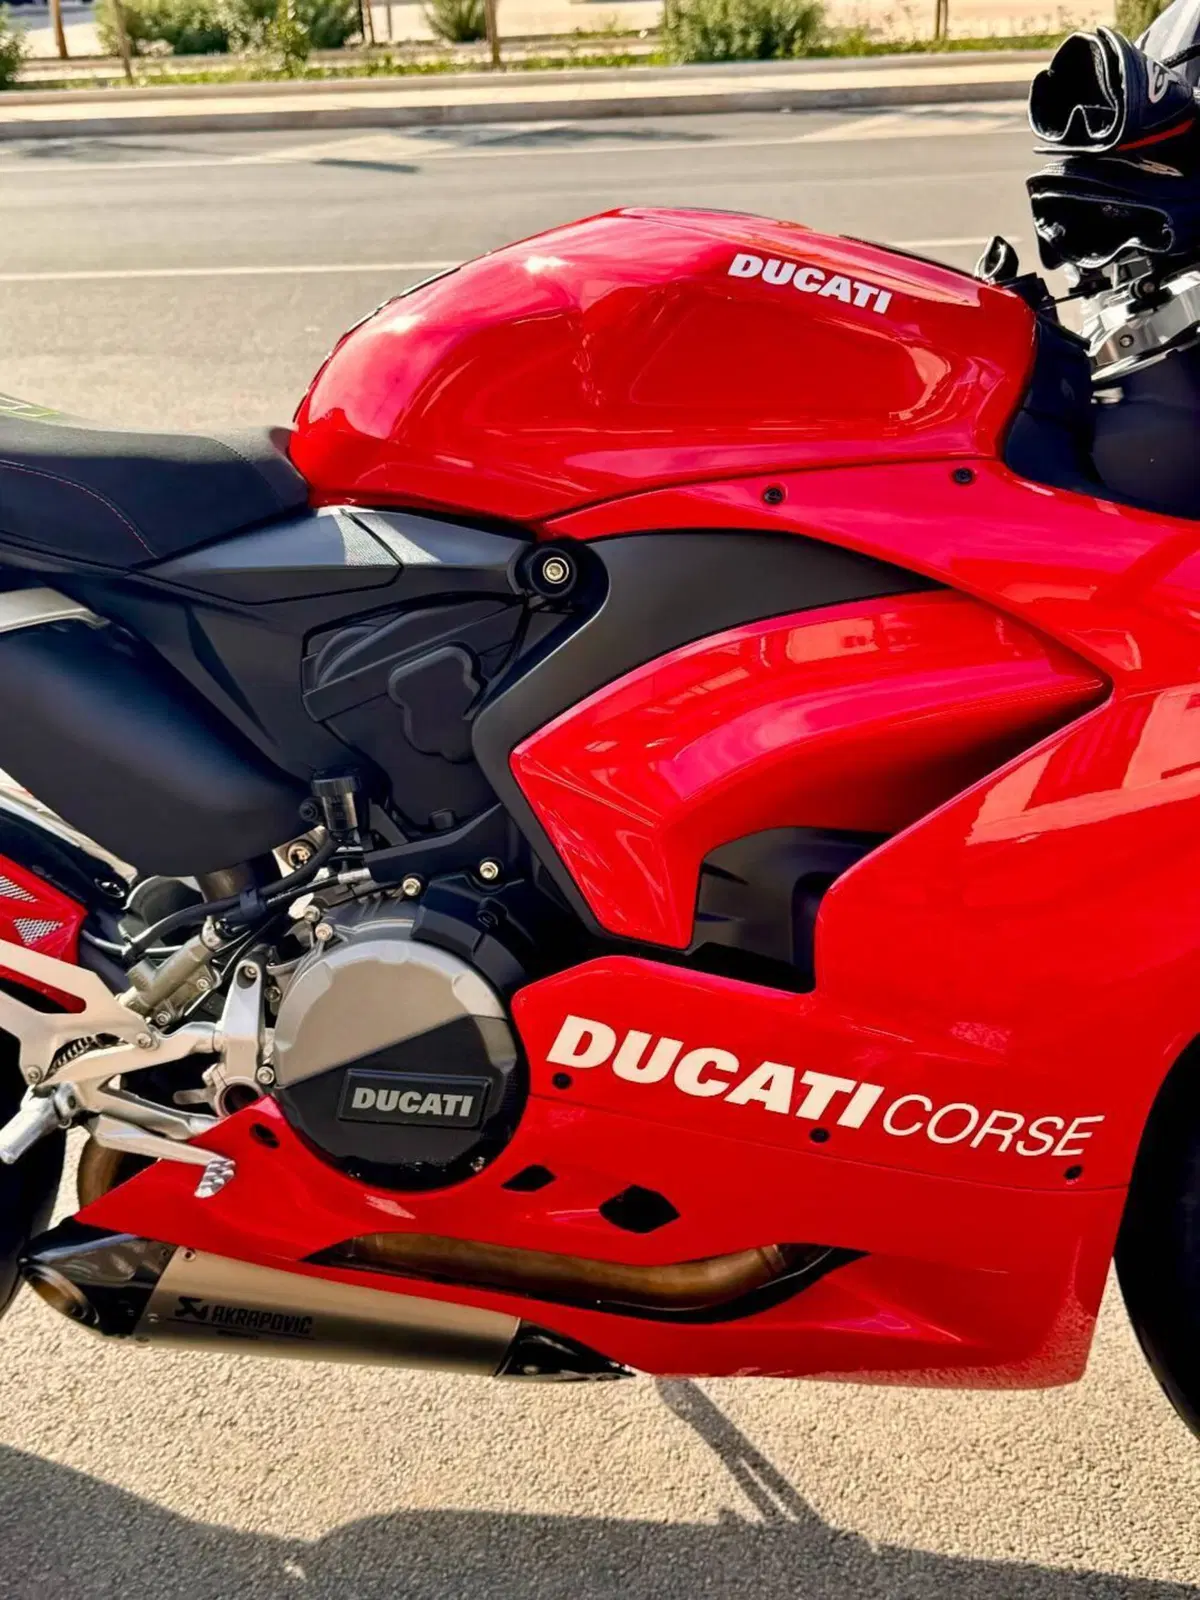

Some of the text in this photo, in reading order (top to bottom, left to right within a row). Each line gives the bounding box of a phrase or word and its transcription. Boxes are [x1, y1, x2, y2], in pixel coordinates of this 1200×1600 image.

[727, 252, 893, 314] DUCATI
[351, 1086, 474, 1118] DUCATI
[546, 1015, 1105, 1157] DUCATI CORSE
